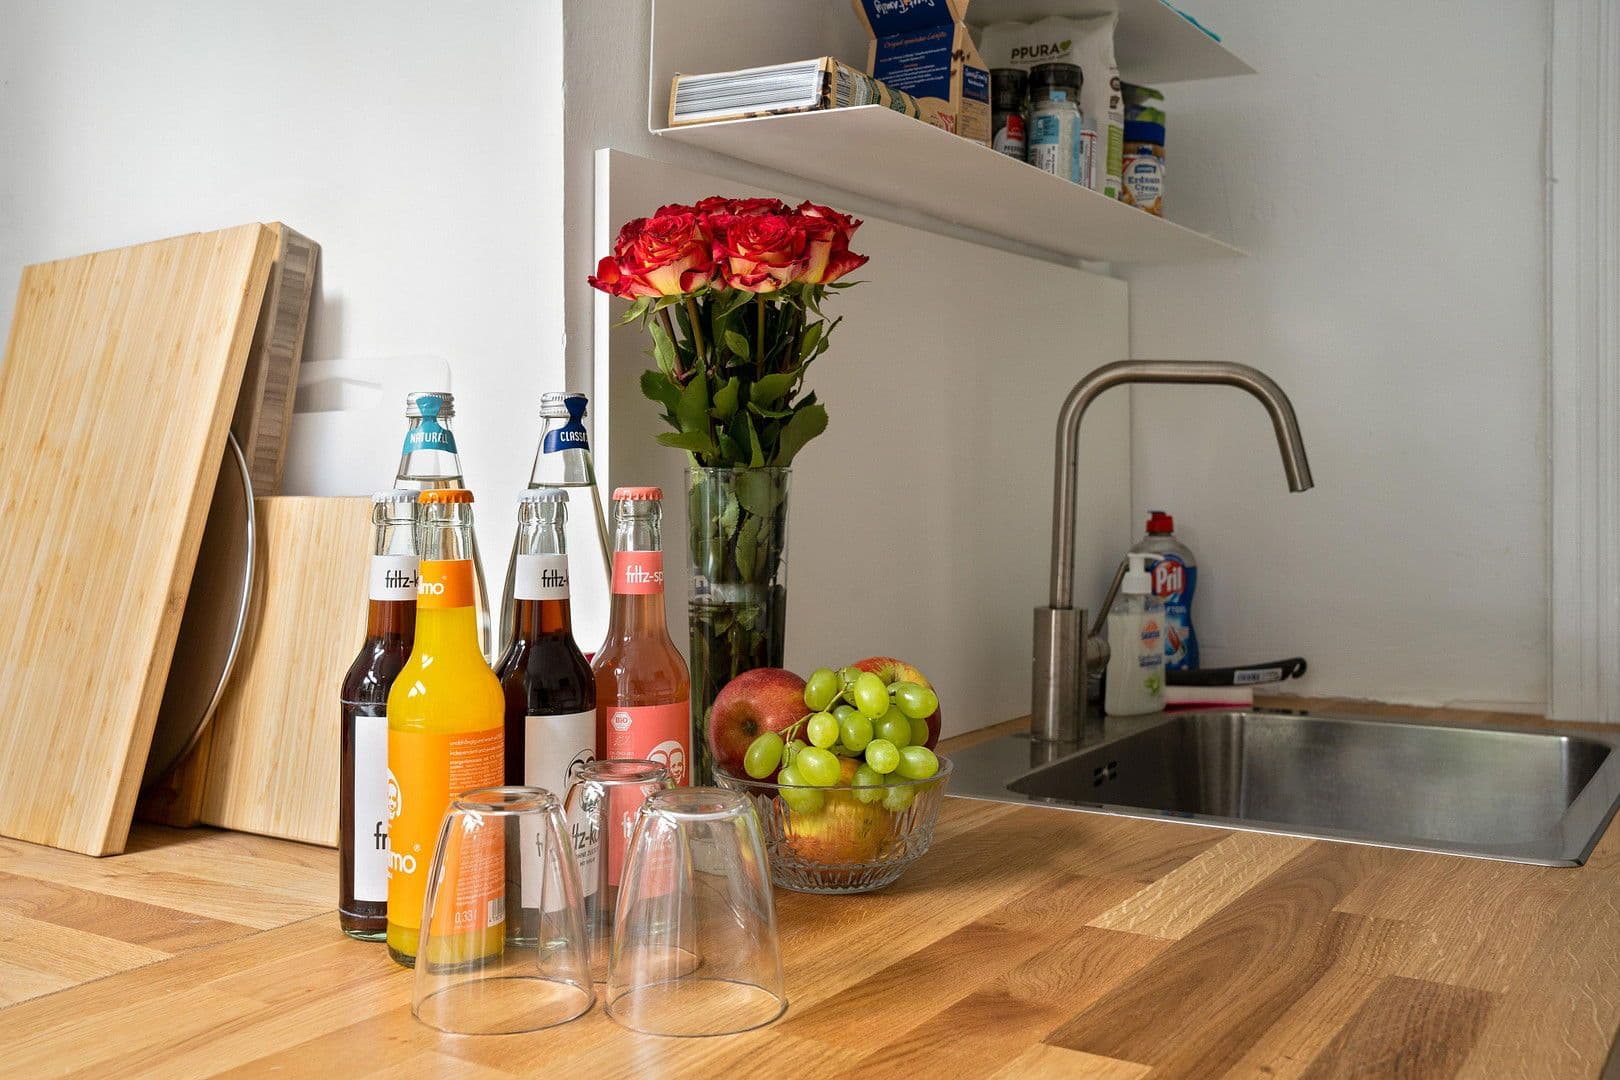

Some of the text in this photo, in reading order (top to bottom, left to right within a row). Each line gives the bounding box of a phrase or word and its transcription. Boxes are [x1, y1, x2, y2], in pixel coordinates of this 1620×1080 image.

[1011, 43, 1060, 59] PPURA
[410, 432, 448, 444] NATURELL
[560, 432, 587, 443] CLASSI
[1156, 566, 1183, 592] Pril
